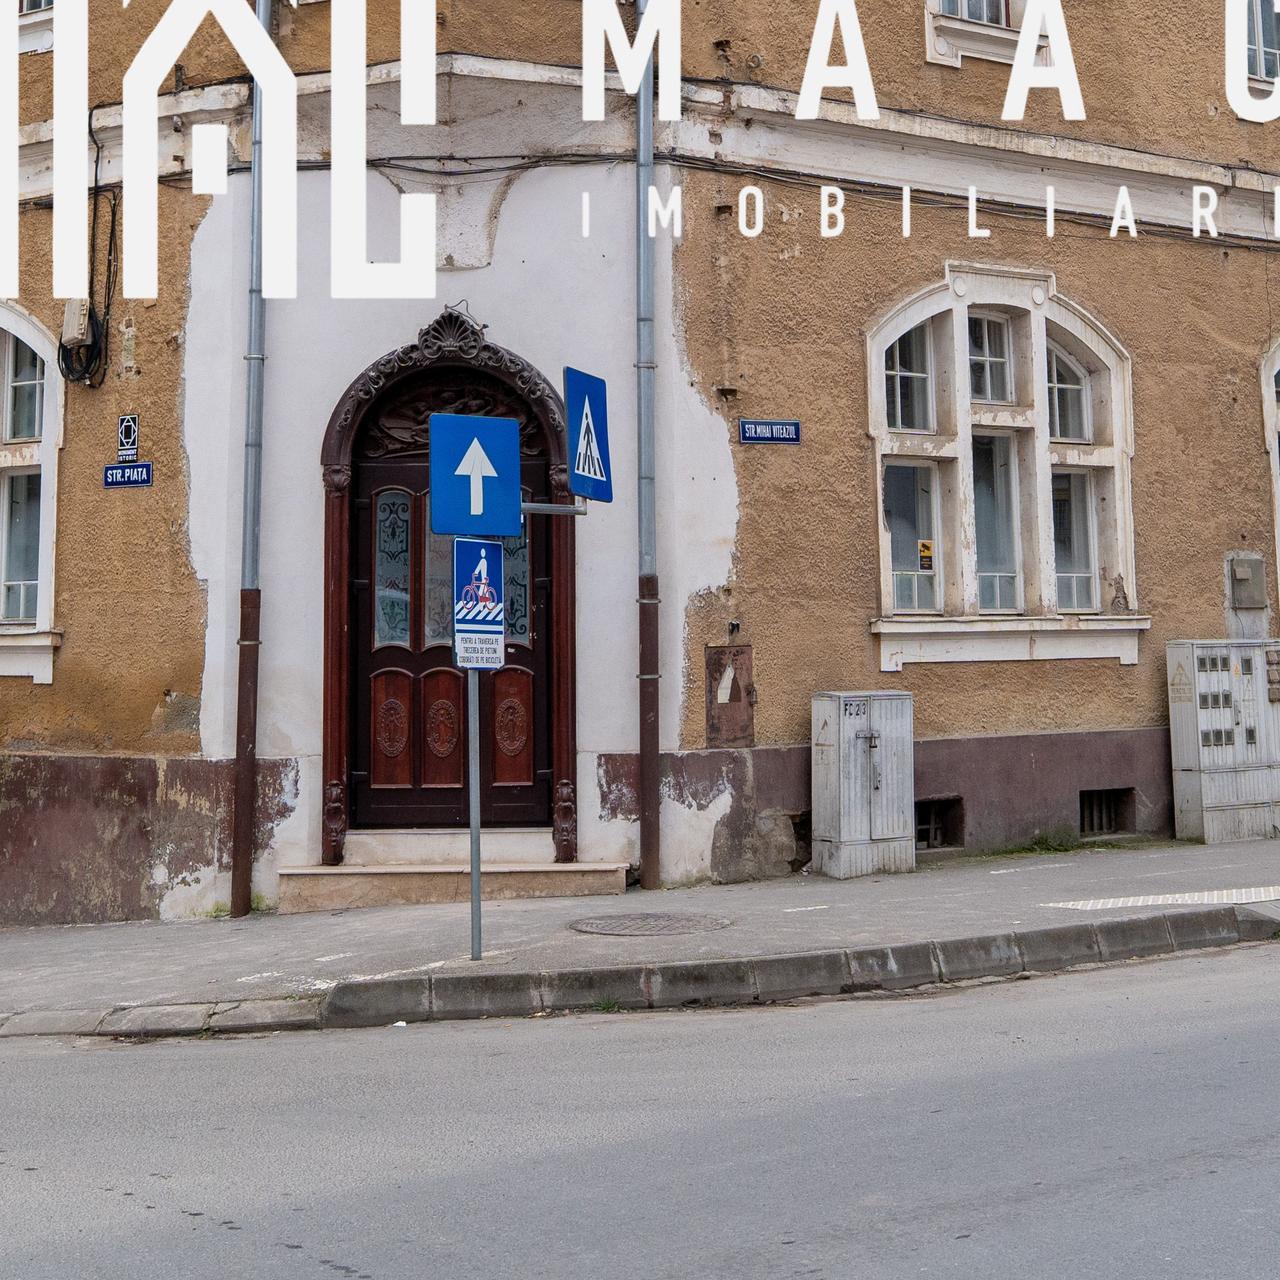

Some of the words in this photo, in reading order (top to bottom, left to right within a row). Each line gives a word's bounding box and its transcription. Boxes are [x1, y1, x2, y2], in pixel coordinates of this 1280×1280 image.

[772, 426, 796, 438] VITEAZUL
[460, 637, 474, 645] PENTRU
[478, 637, 494, 645] TRAVERSA
[463, 646, 479, 655] TRECEREA
